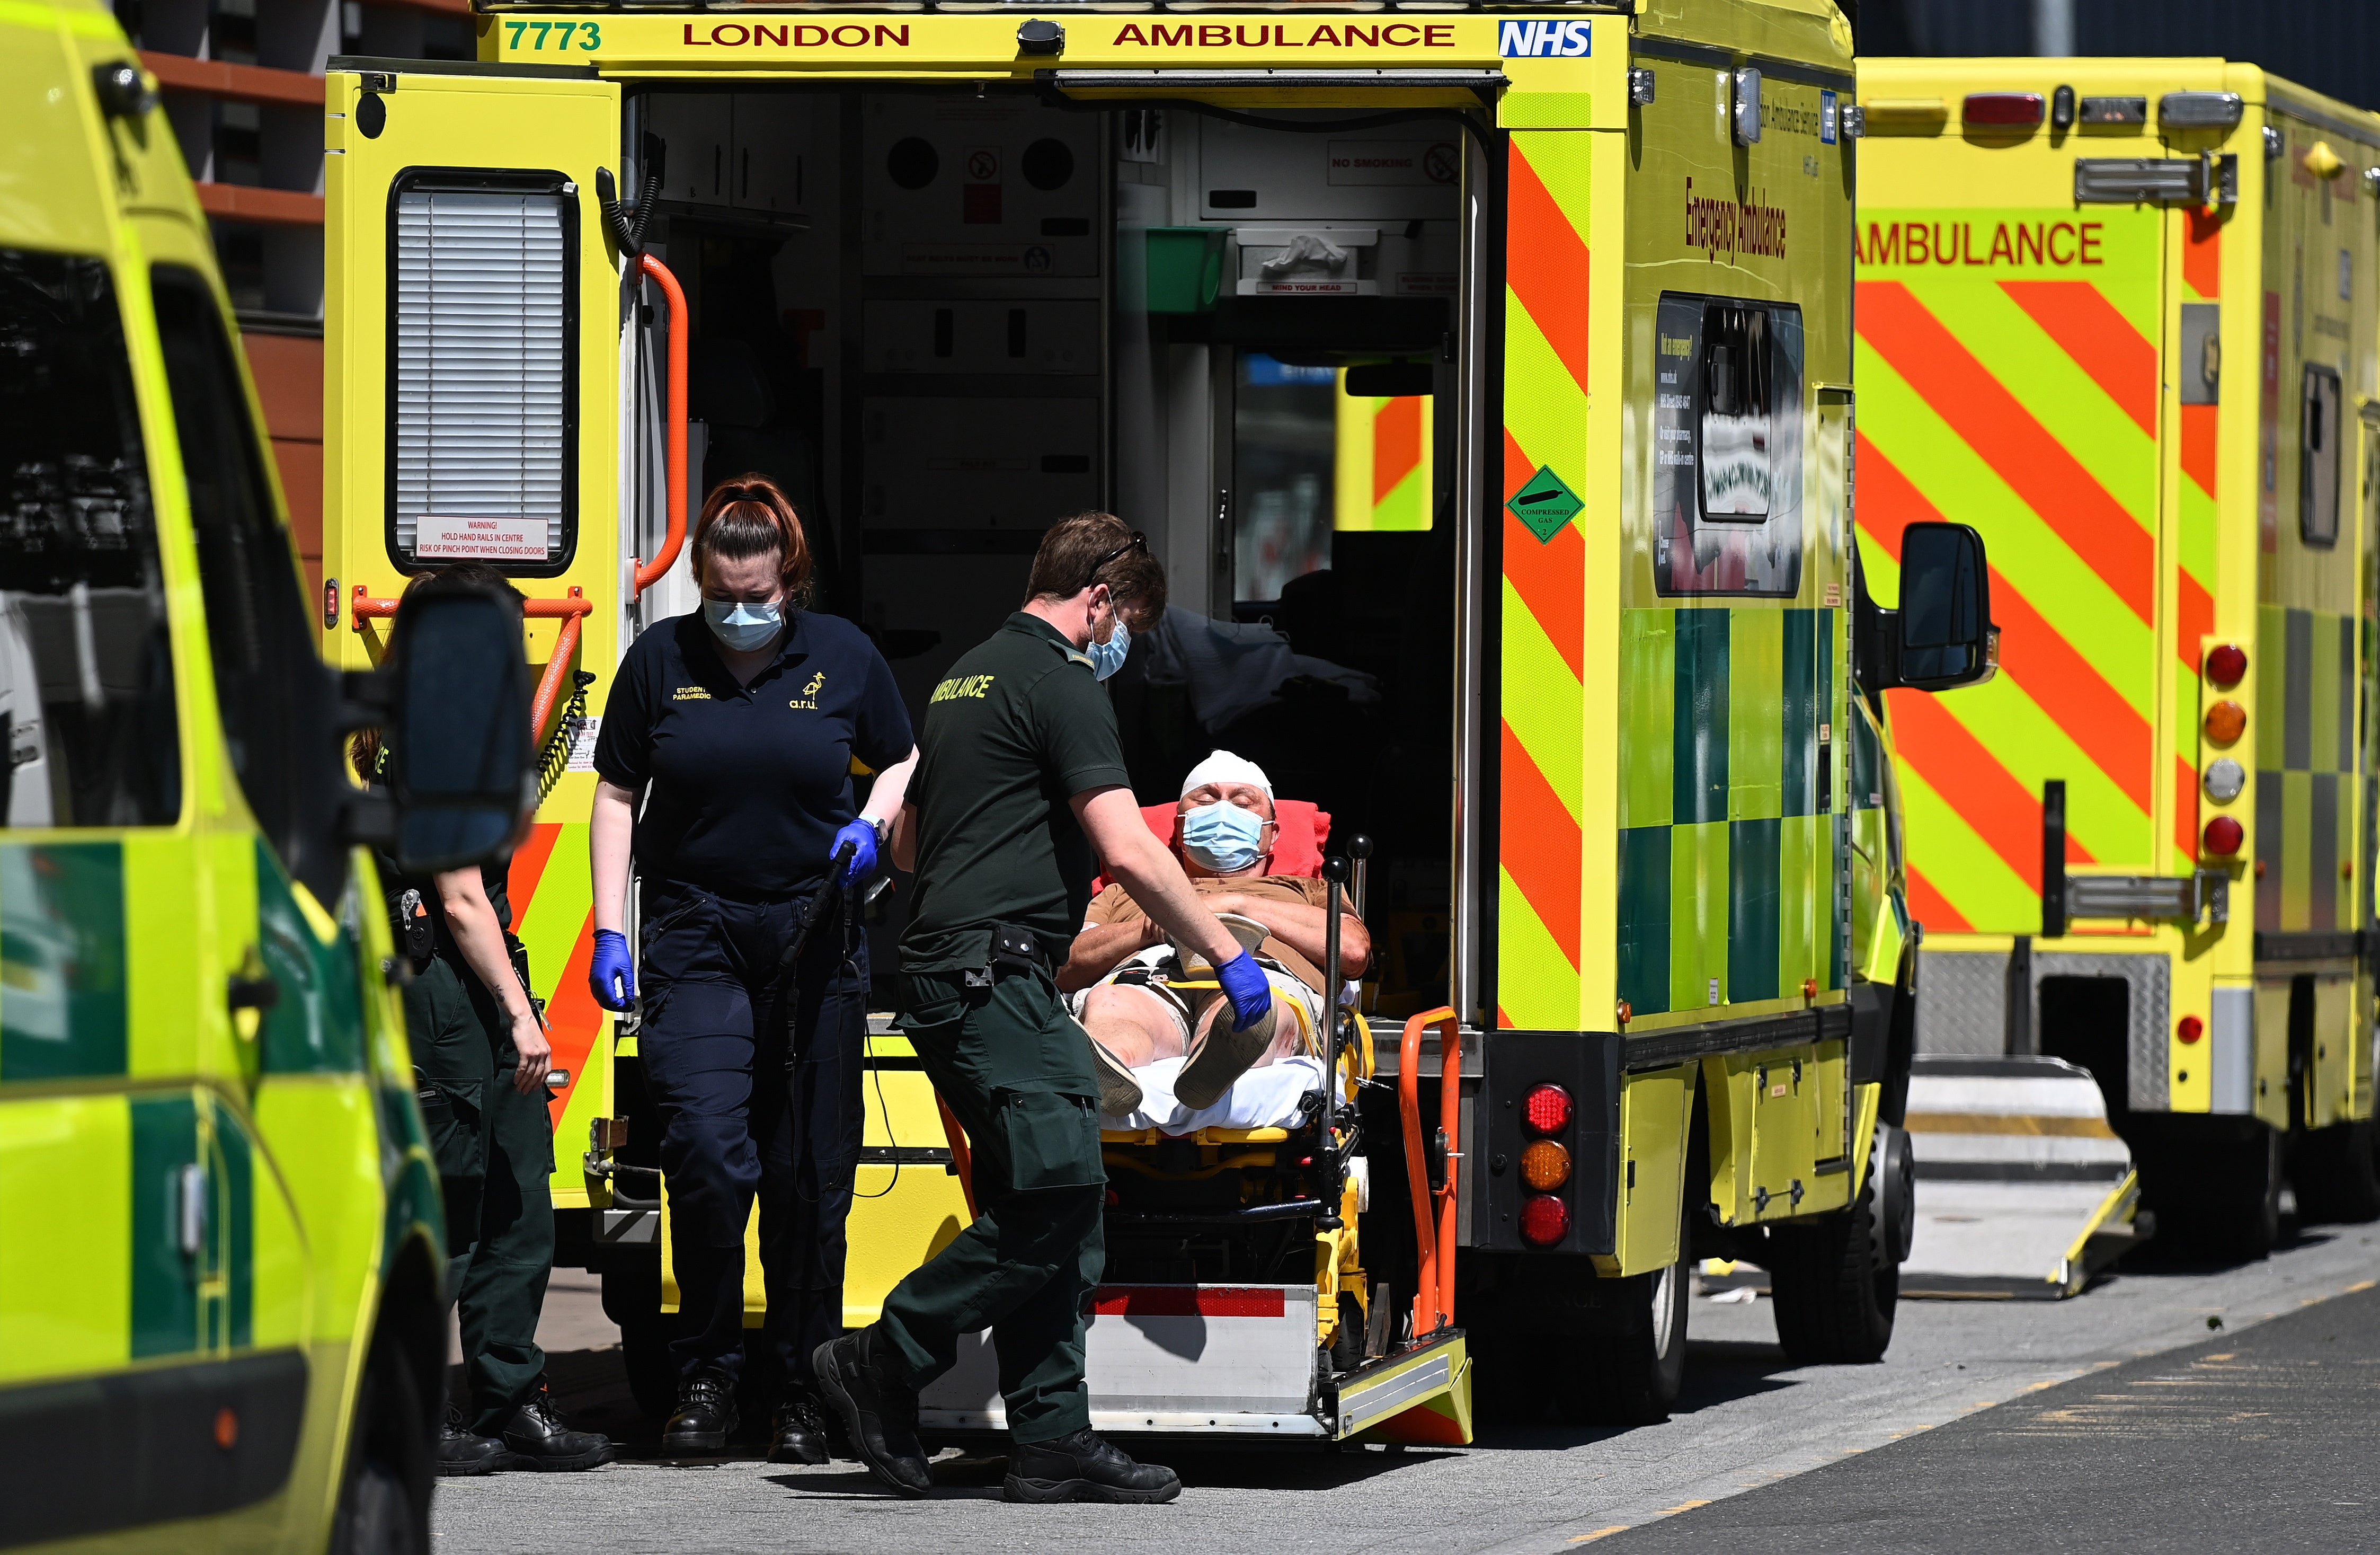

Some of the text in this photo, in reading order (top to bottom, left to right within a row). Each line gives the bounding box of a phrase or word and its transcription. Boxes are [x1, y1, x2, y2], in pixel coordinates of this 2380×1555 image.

[505, 22, 601, 51] 7773
[683, 23, 1455, 47] LONDON AMBULANCE
[1499, 21, 1590, 56] NHS
[1332, 158, 1413, 167] NO SMOKING
[1686, 176, 1786, 267] Emergency Ambulance
[468, 521, 498, 529] WARNING!
[441, 532, 458, 541] HOLD
[459, 533, 476, 541] HAND
[477, 533, 494, 542] RAILS
[420, 544, 545, 555] RISK OF PINCH POINT WHEN CLOSING DOORS
[789, 700, 818, 710] a.r.u.
